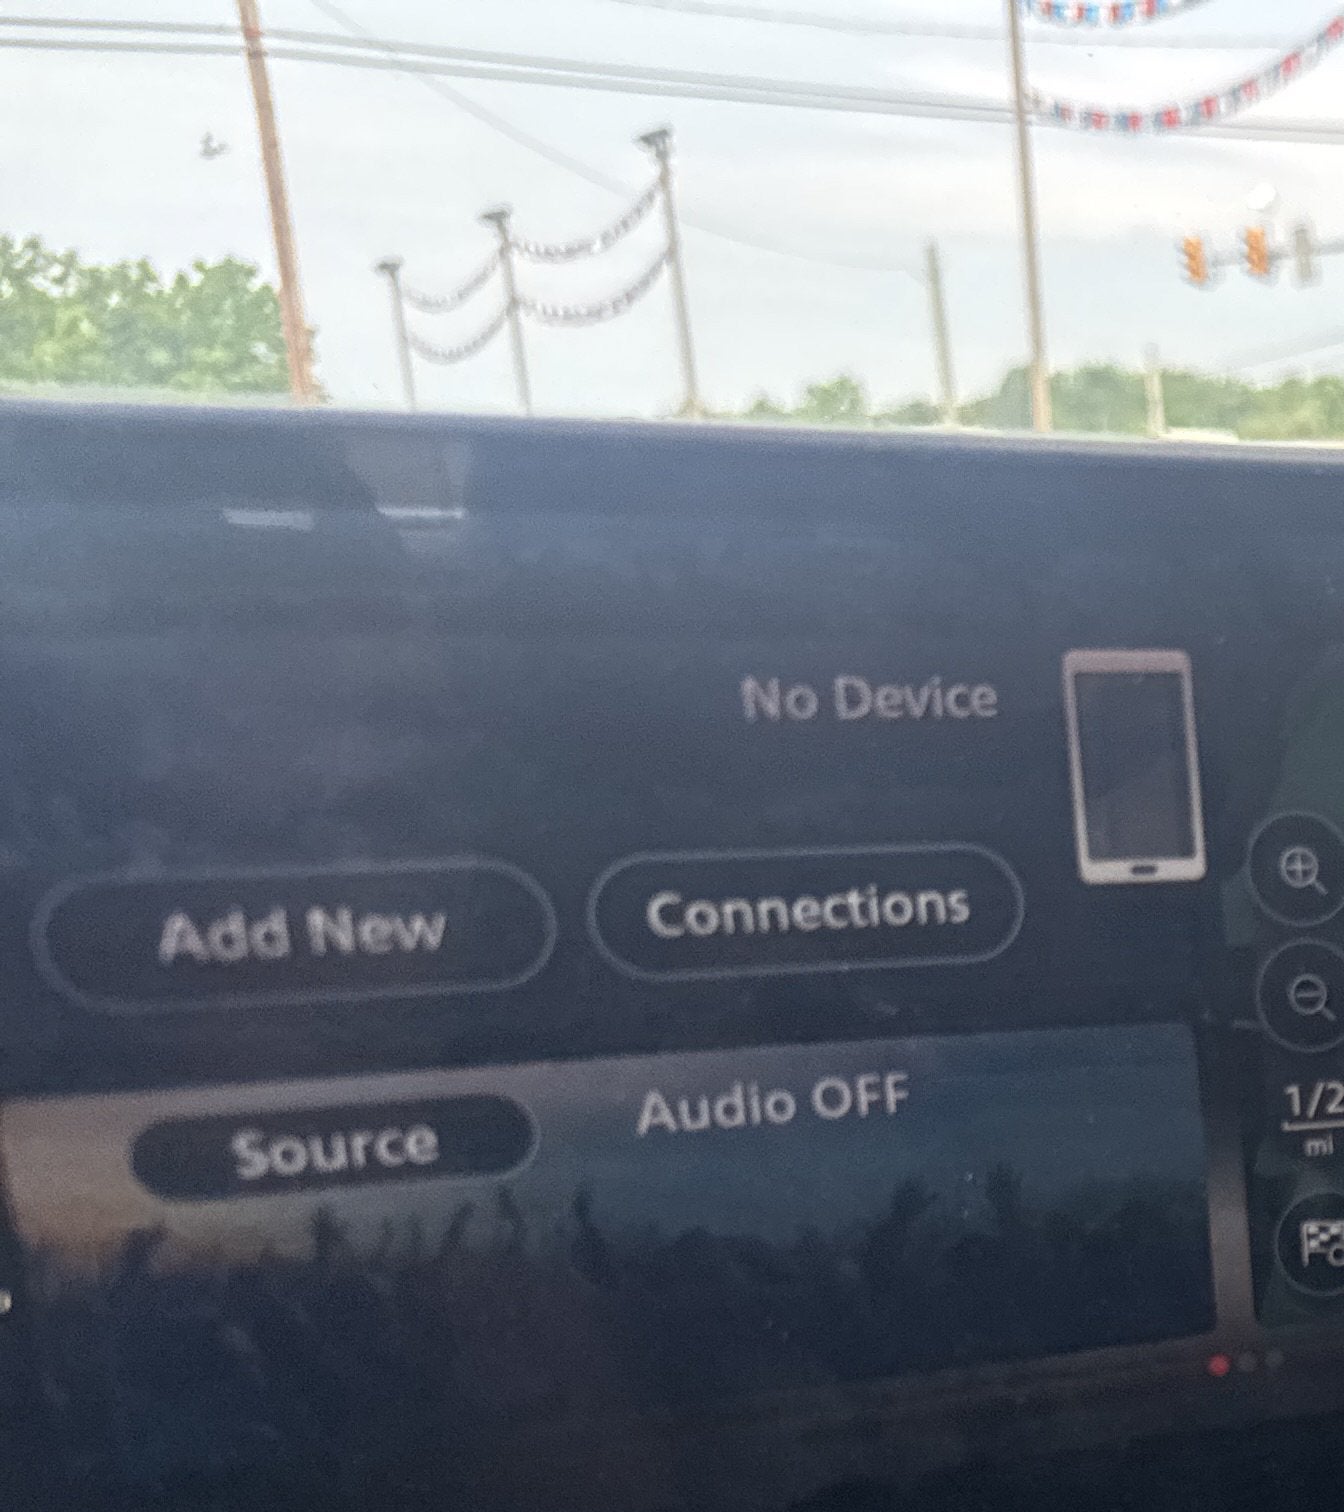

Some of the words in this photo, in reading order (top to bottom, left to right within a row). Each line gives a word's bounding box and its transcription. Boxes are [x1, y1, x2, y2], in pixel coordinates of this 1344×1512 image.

[740, 673, 819, 720] No
[833, 674, 998, 721] Device
[158, 910, 291, 964] Add
[307, 905, 448, 957] New
[646, 885, 971, 939] Connections
[636, 1081, 797, 1137] Audio
[811, 1073, 910, 1119] OFF
[231, 1121, 440, 1181] Source
[1304, 1132, 1334, 1157] mi
